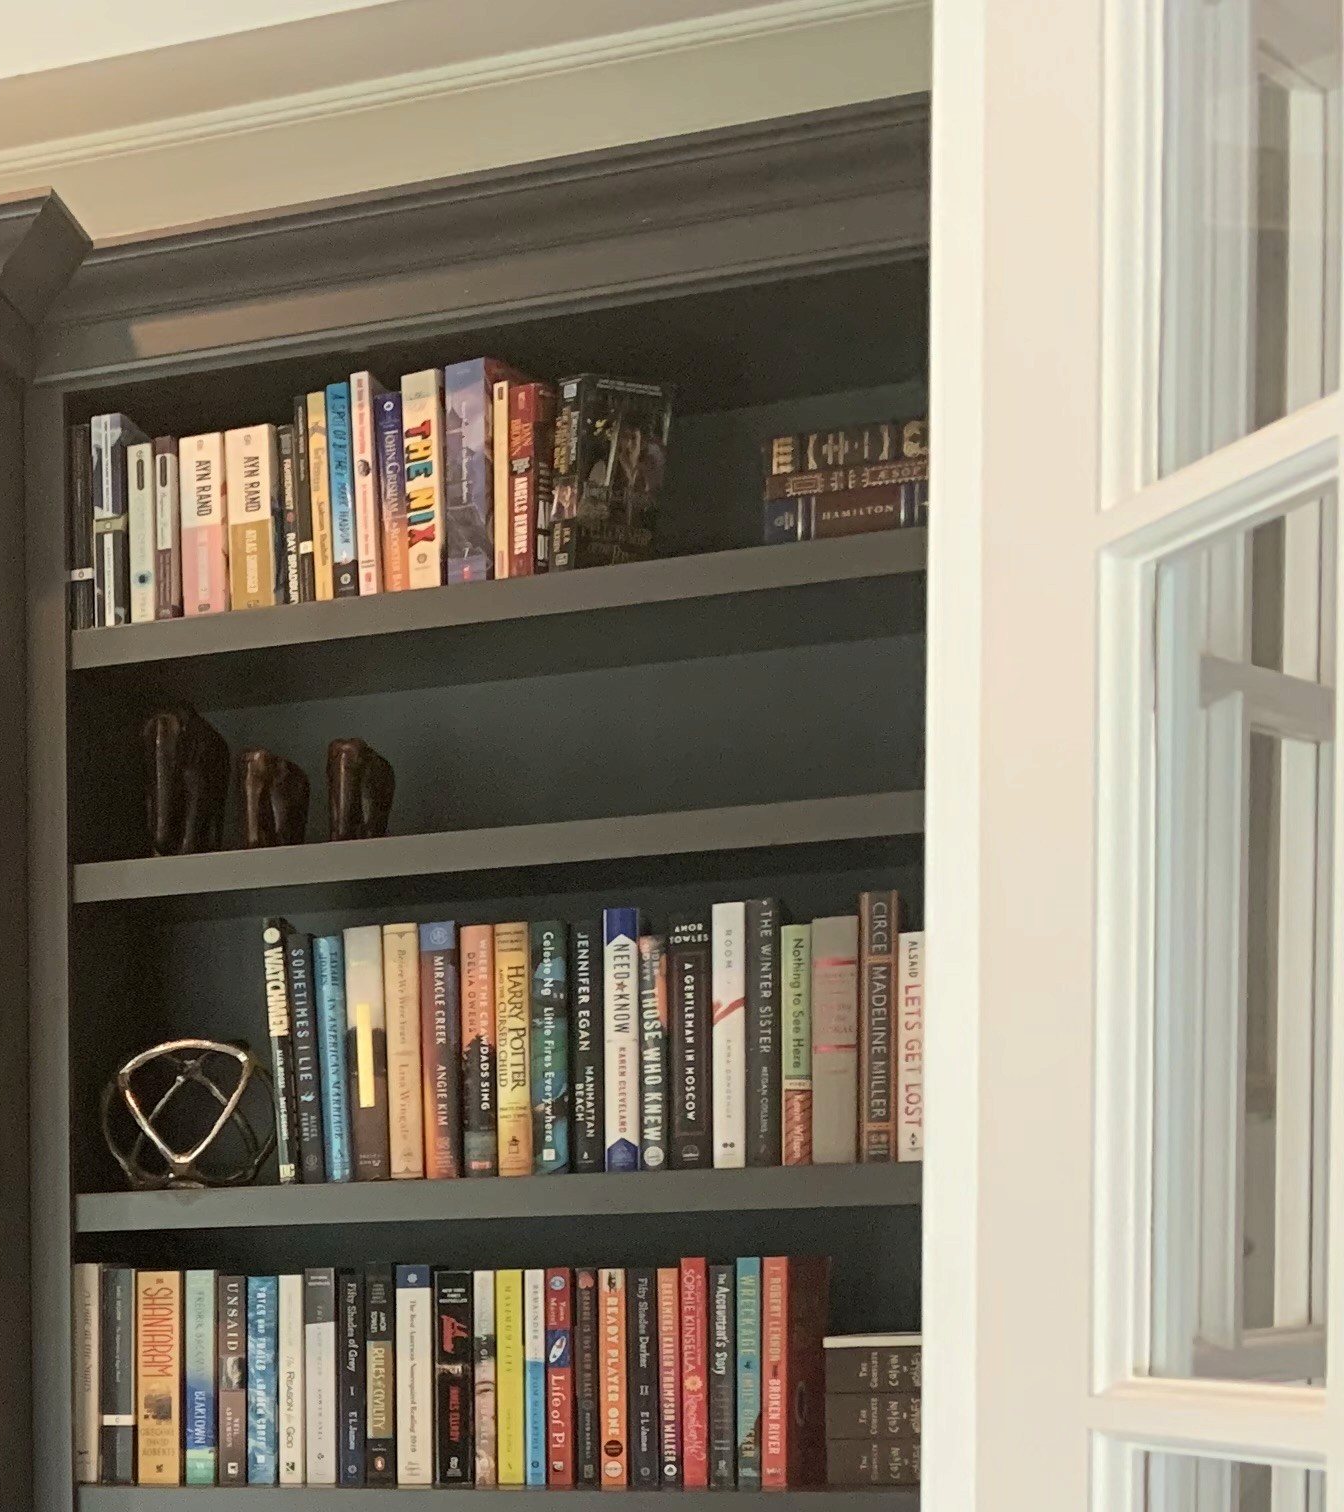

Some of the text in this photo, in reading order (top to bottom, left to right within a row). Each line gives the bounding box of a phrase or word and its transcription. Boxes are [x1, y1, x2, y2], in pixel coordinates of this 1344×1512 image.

[195, 460, 213, 517] AYN RAND
[243, 456, 261, 513] AYN RAND
[383, 429, 401, 513] JOHN GRISHAM
[405, 420, 436, 549] THE NIX
[286, 532, 297, 552] RAY
[513, 476, 529, 555] ANGELS DEMONS
[822, 503, 895, 521] HAMILTON
[540, 931, 555, 996] Celeste Ng
[669, 933, 709, 945] TOWLES
[674, 923, 703, 934] AMOR
[725, 929, 733, 969] ROOM
[872, 902, 888, 952] CIRCE
[908, 941, 919, 978] ALSAID
[263, 946, 290, 1038] WATCHMEN
[291, 949, 310, 1038] SOMETIMES
[433, 956, 448, 1045] MIRACLE CREEK
[467, 951, 478, 1033] DELIA OWENS
[577, 932, 591, 1051] JENNIFER EGAN
[613, 943, 631, 1035] NEED KNOW
[684, 975, 695, 1044] GENTLEMAN
[759, 910, 773, 1054] THE WINTER SISTER
[790, 938, 805, 1069] Nothing to See Here
[478, 939, 491, 1110] WHERE THE CRAWDADS SING
[497, 1001, 508, 1047] CURSED
[507, 965, 527, 1092] HARRY POTTER
[684, 1049, 696, 1061] IN
[872, 966, 889, 1119] MADELINE MILLER
[905, 985, 923, 1127] LETS GET LOST
[298, 1057, 312, 1081] LIE
[327, 997, 343, 1140] AN AMERICAN MARRIAGE
[436, 1064, 450, 1126] ANGIE KIM
[498, 1050, 509, 1088] CHILD
[540, 1006, 557, 1142] Little Fires Everywhere
[574, 1083, 585, 1121] BEACH
[585, 1066, 595, 1138] MANHATTAN
[617, 1047, 628, 1134] KAREN CLEVELAND
[641, 988, 663, 1141] THOSE WHO KNEW
[685, 1067, 696, 1121] MOSCOW
[793, 1125, 806, 1159] Wilson
[142, 1287, 175, 1378] SHANTARAM
[226, 1283, 239, 1351] UNSAID
[346, 1283, 360, 1372] Fifty Shades of Grey
[532, 1284, 540, 1341] REMAINDER
[636, 1277, 650, 1369] Fifty Shades Darker
[684, 1268, 696, 1373] SOPHIE KINSELLA
[740, 1275, 757, 1357] WRECKAGE
[769, 1278, 781, 1318] ROBERT
[607, 1297, 620, 1436] READY PLAYER ONE
[769, 1321, 781, 1361] LENNON
[194, 1391, 207, 1444] BEARTOWN
[372, 1347, 386, 1430] RULES CIVILITY
[551, 1374, 564, 1449] Life of Pi
[662, 1337, 677, 1462] KAREN THOMPSON WALKER
[769, 1379, 781, 1455] BROKEN RIVER
